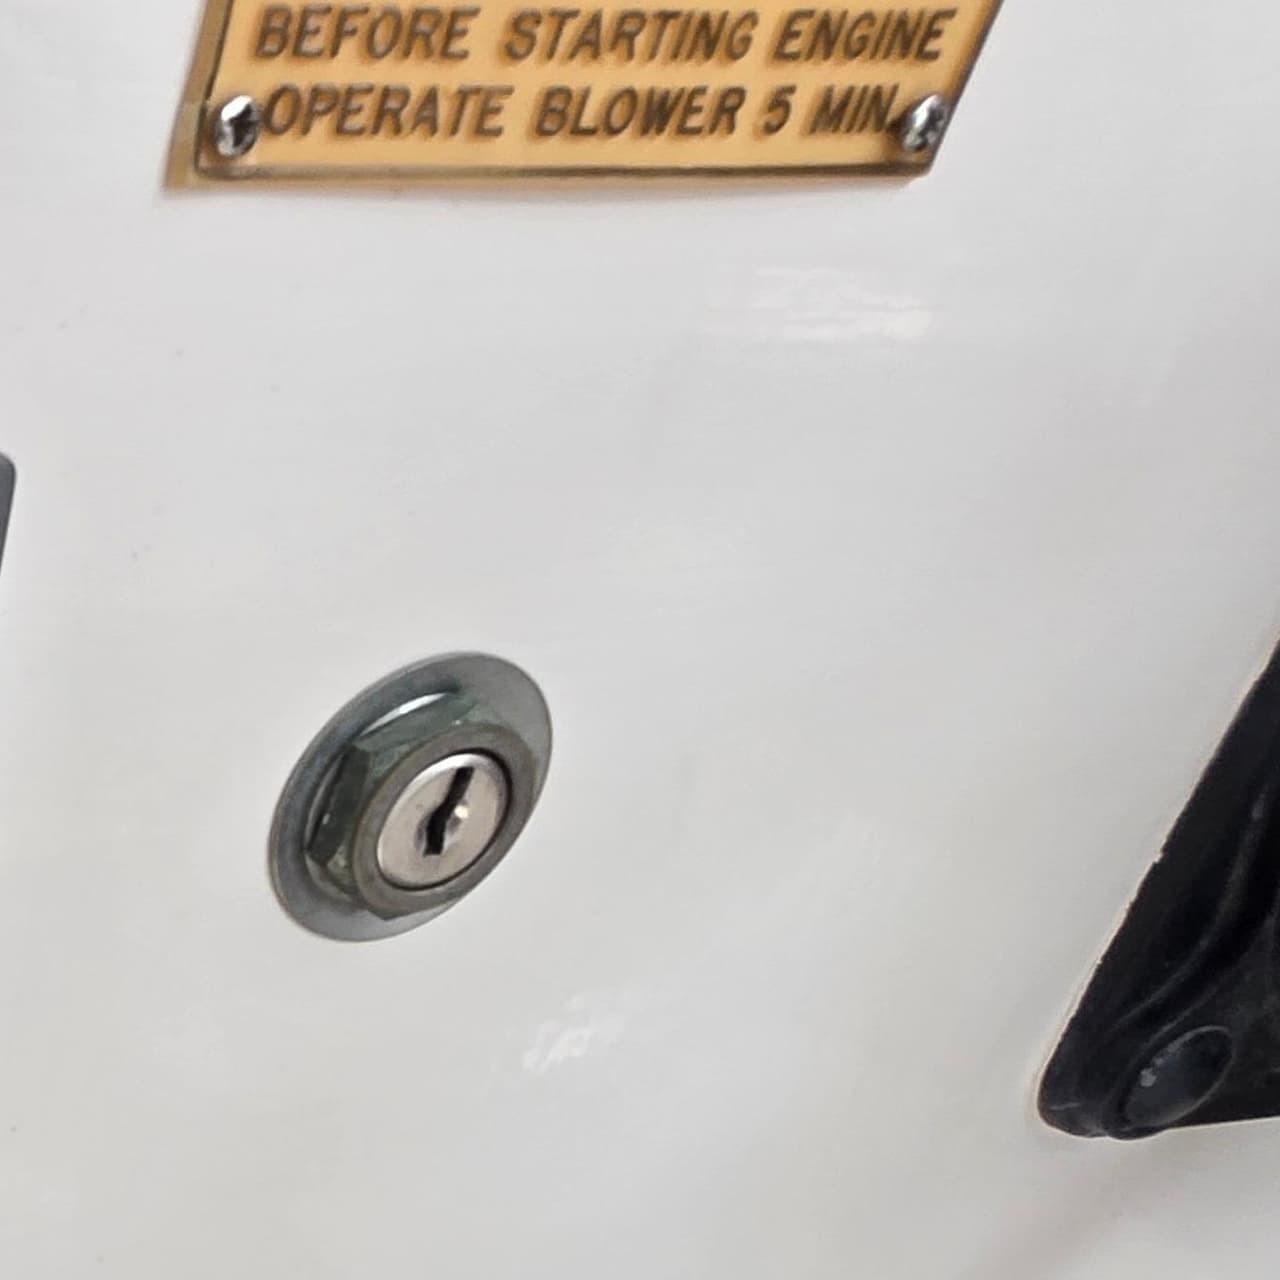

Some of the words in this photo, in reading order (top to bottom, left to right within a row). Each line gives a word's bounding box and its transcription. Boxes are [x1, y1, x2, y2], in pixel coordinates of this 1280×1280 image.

[253, 6, 482, 61] BEFORE
[503, 8, 759, 62] STARTING
[772, 8, 958, 62] ENGINE
[262, 82, 515, 138] OPERATE
[534, 84, 747, 137] BLOWER
[761, 84, 798, 136] 5
